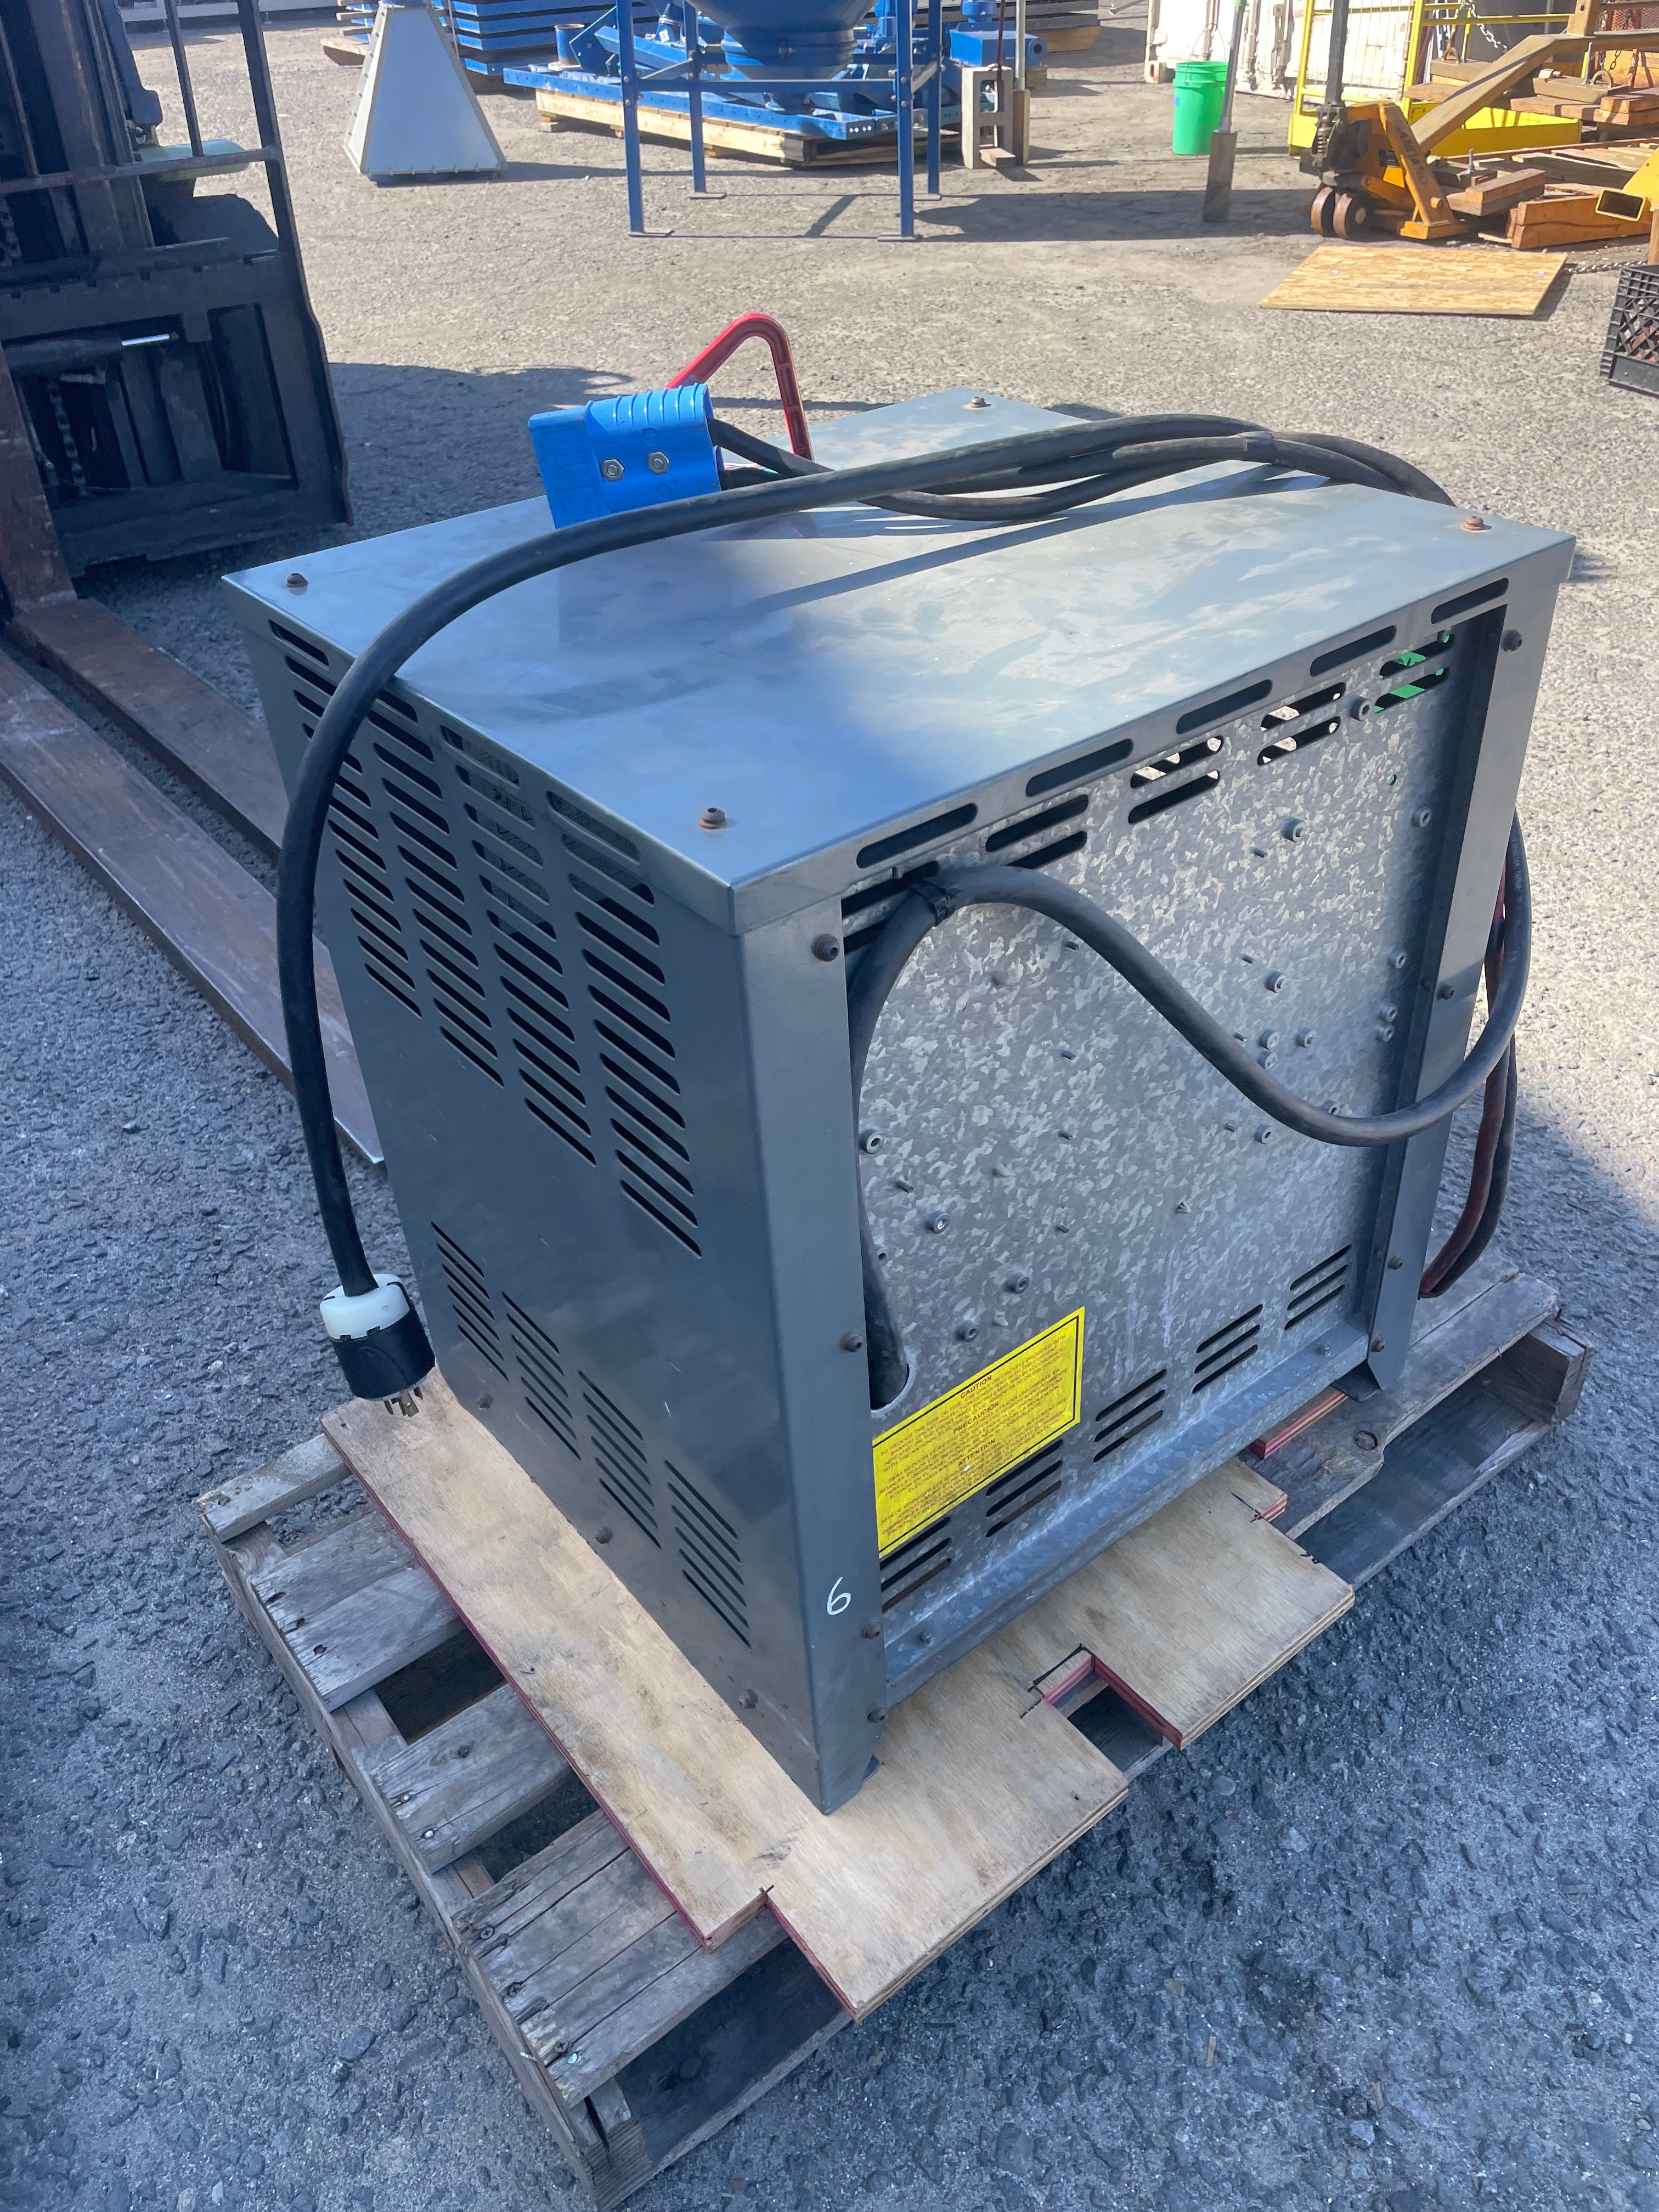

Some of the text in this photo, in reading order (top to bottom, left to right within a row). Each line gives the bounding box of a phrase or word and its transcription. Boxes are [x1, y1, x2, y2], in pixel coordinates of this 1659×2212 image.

[960, 1374, 992, 1400] CAUTION
[953, 1398, 998, 1435] PRECAUCIÓN
[958, 1437, 995, 1467] ATTENTION
[827, 1577, 851, 1616] 6
